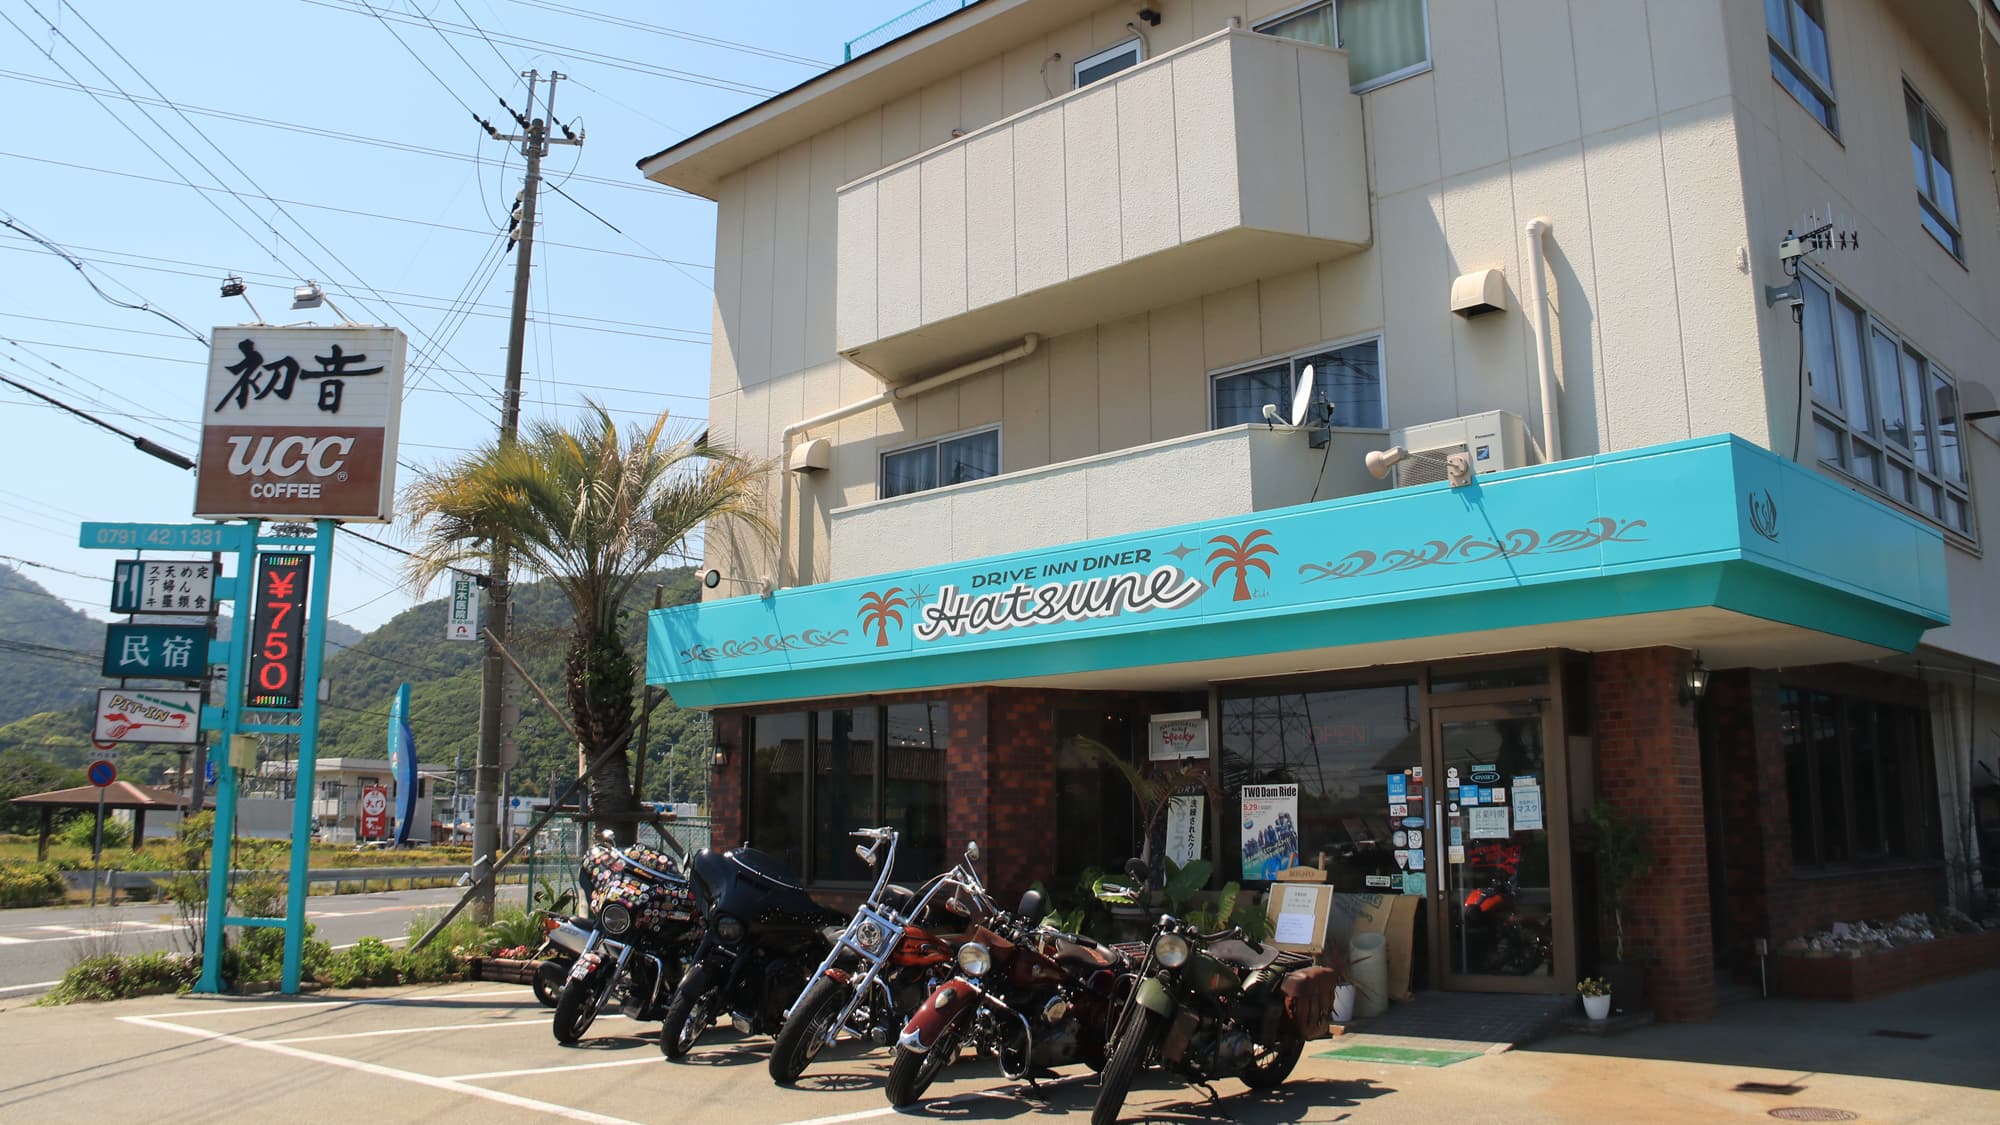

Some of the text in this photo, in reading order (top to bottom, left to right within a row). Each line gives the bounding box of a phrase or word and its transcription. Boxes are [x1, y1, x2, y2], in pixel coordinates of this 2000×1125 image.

[214, 339, 385, 414] 初音
[227, 435, 355, 477] UCC
[251, 483, 321, 499] COFFEE
[146, 566, 160, 608] ステーキ
[177, 566, 193, 609] めん類
[194, 565, 209, 609] 定食
[971, 548, 1152, 589] DRIVE INN DINER
[915, 567, 1199, 640] Hatsune
[119, 634, 194, 668] 民宿
[260, 571, 297, 690] ¥750
[109, 694, 171, 722] PIT-IN
[1243, 785, 1297, 798] TWO Dam Ride
